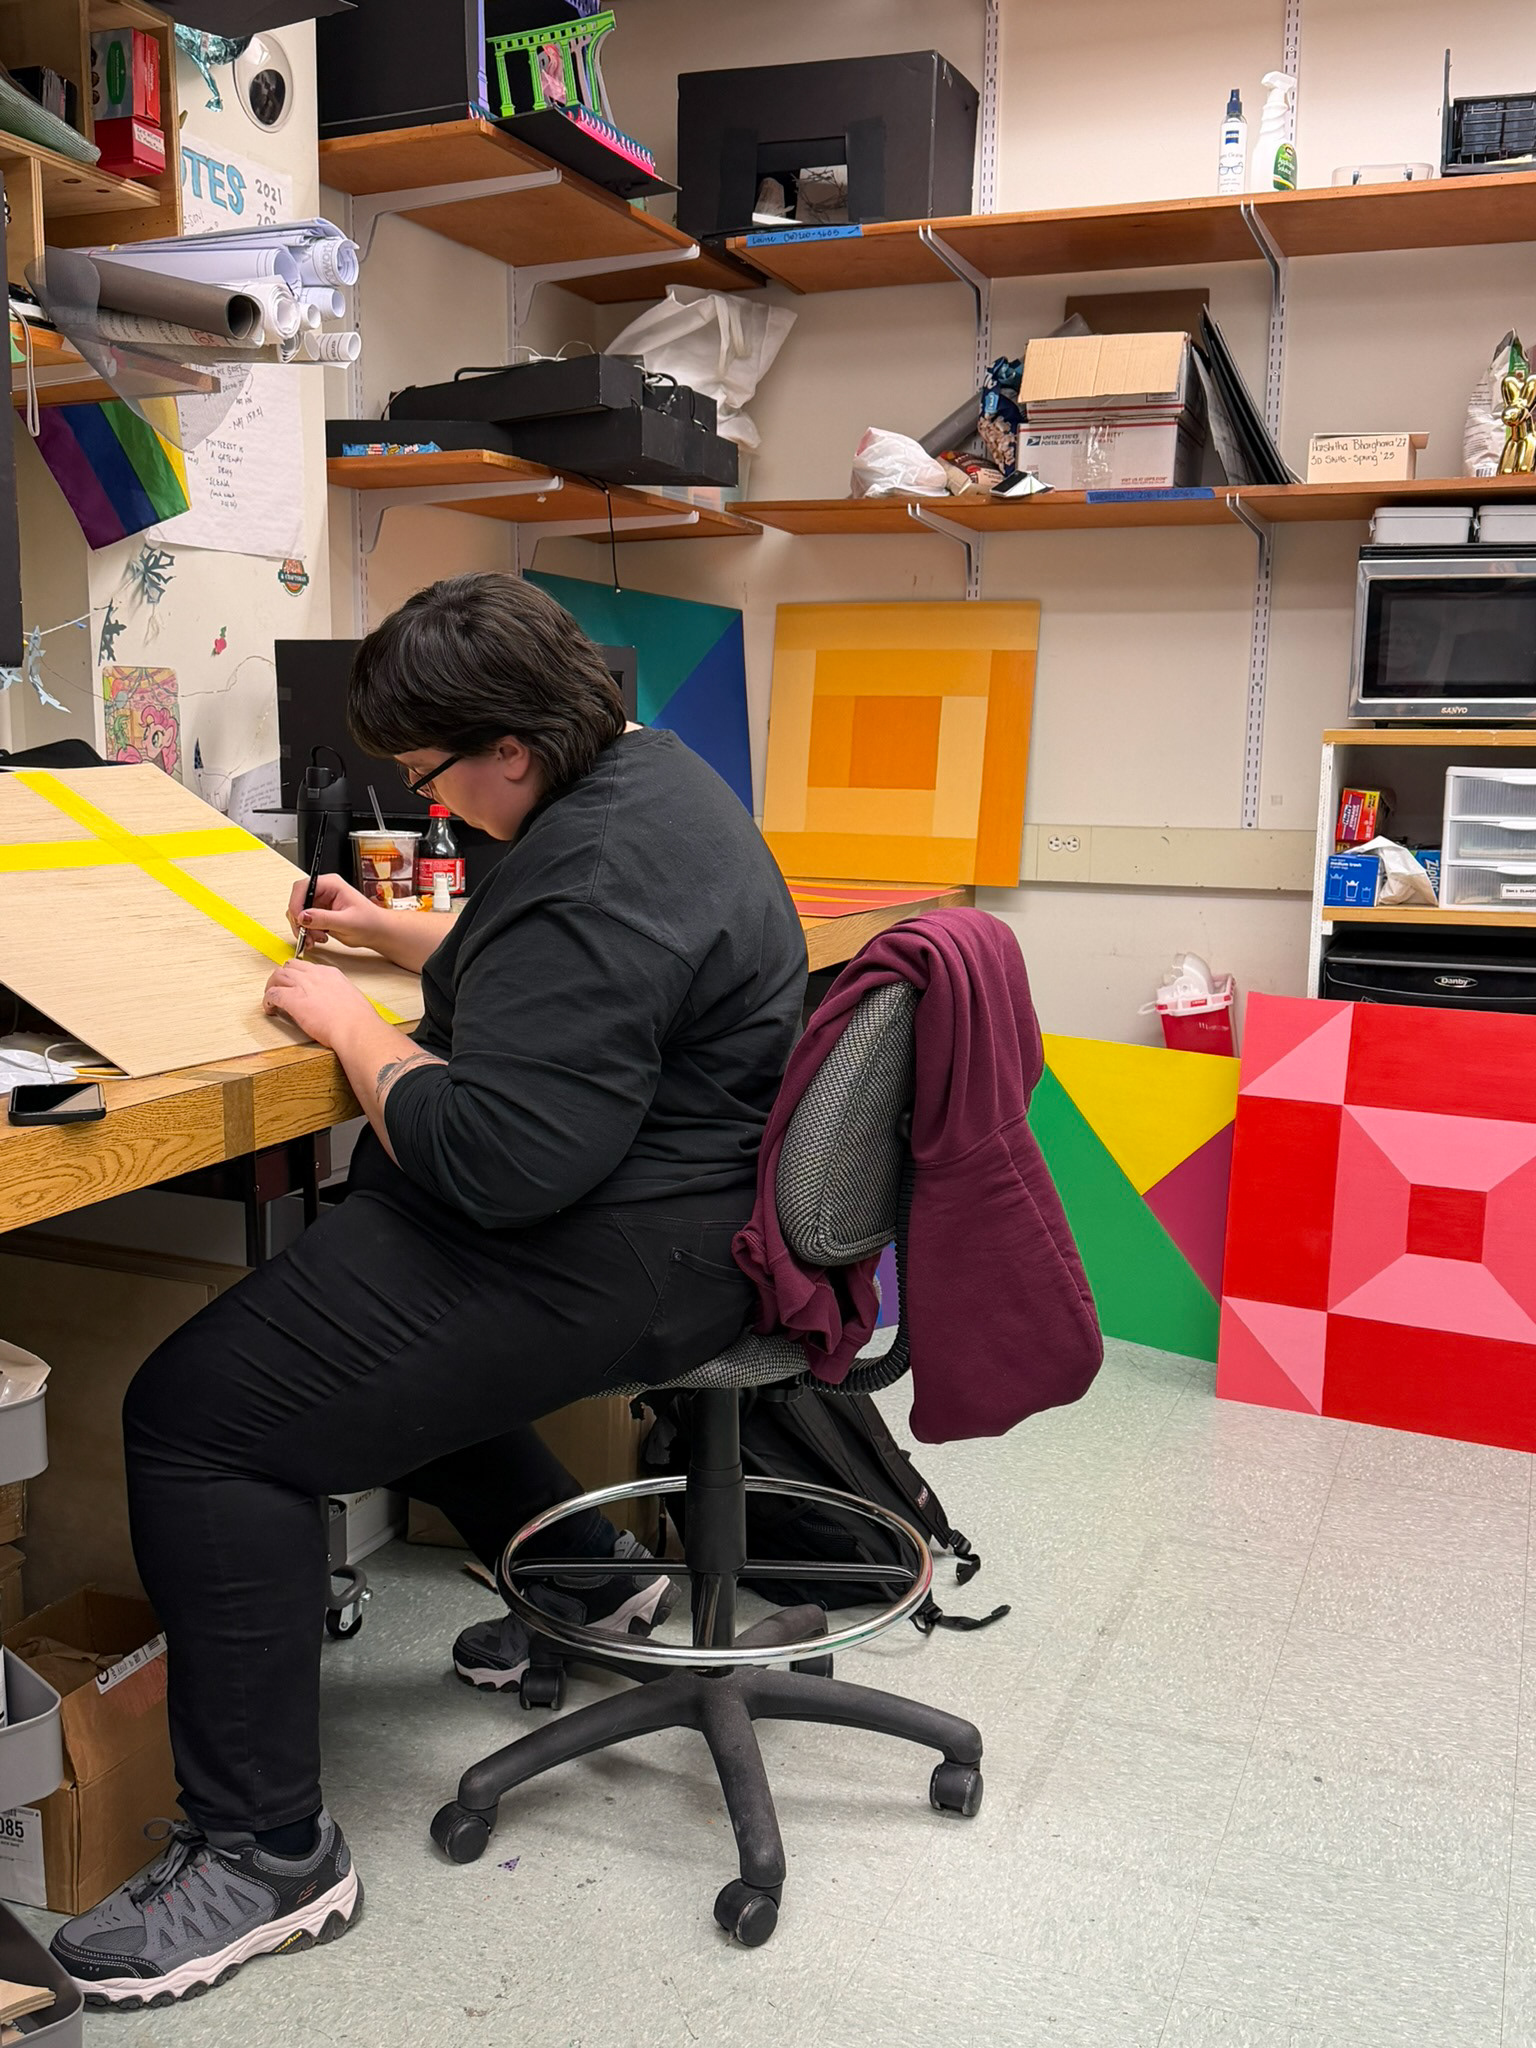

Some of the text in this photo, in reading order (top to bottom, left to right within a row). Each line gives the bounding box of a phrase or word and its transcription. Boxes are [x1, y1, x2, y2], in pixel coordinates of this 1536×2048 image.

[255, 178, 282, 205] 2021
[263, 201, 276, 216] to
[1440, 706, 1468, 714] SANYO
[1424, 858, 1440, 893] Ziploc
[1440, 974, 1468, 986] Danby
